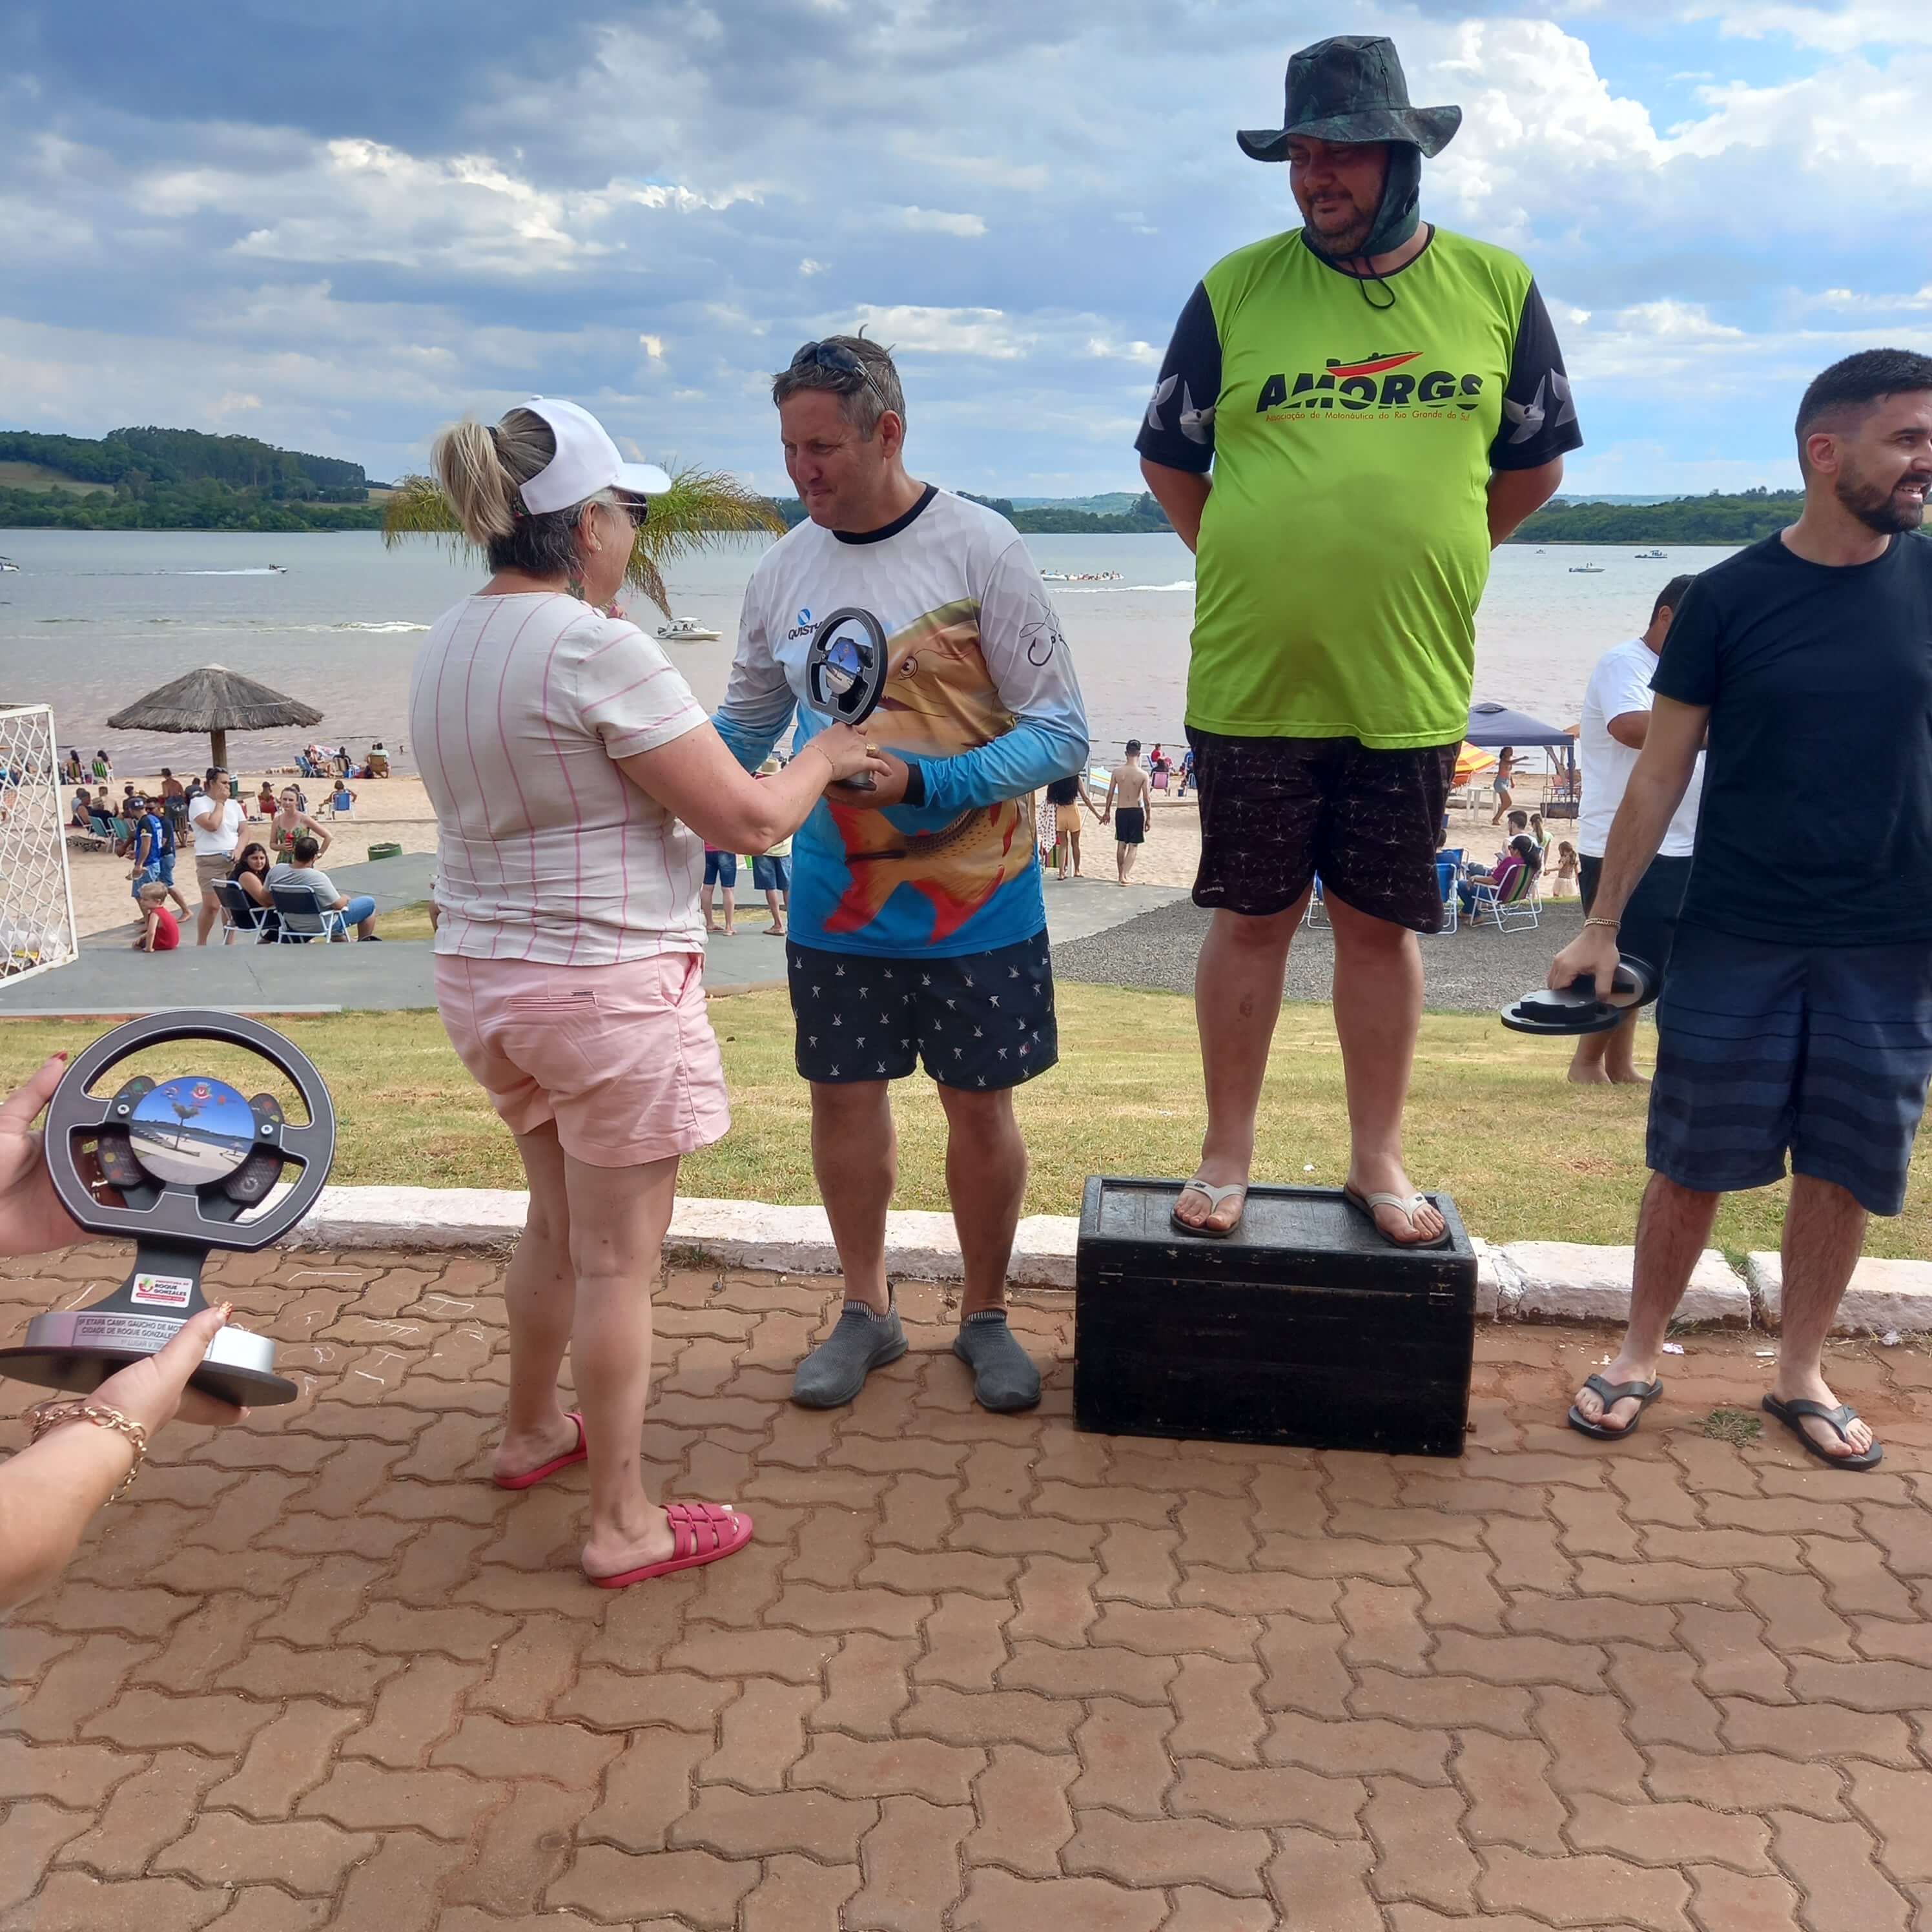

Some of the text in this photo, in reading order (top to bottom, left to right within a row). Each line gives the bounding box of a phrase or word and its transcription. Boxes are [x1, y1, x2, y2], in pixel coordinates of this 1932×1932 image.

[1256, 371, 1483, 414] AMORGS
[1266, 411, 1305, 422] Associação
[1325, 411, 1374, 419] Motonáutica
[1412, 410, 1442, 418] Grande
[1447, 411, 1457, 419] do
[1460, 412, 1470, 421] Sul
[154, 1288, 187, 1297] GONZALES
